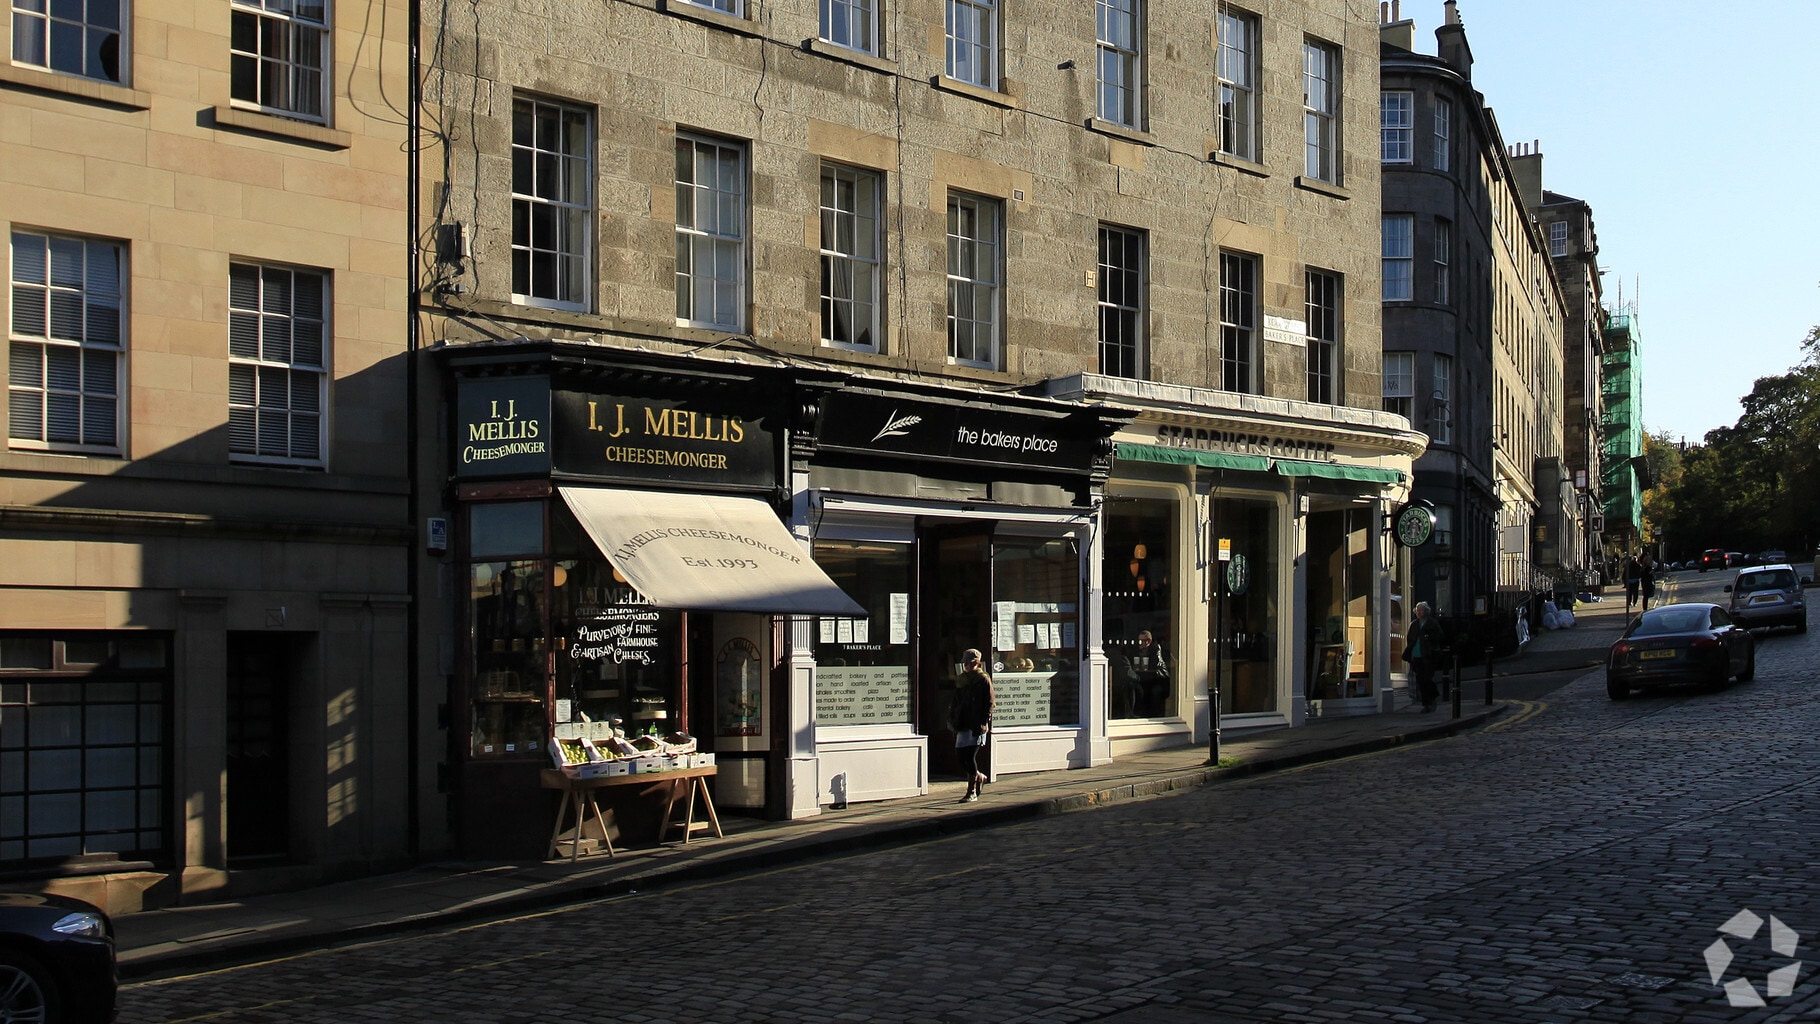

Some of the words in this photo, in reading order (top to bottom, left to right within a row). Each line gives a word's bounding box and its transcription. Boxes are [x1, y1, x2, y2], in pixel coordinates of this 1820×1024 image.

[491, 400, 501, 418] I.
[503, 399, 518, 421] J.
[587, 401, 603, 432] I.
[609, 404, 630, 438] J.
[644, 406, 744, 443] MELLIS
[468, 419, 539, 442] MELLIS
[957, 426, 979, 445] the
[981, 429, 1021, 449] bakers
[1021, 434, 1058, 453] place
[463, 441, 546, 463] CHEESEMONGER
[1157, 425, 1270, 456] STARBUCKS
[1271, 437, 1336, 462] COFFEE
[605, 445, 728, 470] CHEESEMONGER
[667, 527, 801, 565] CHEESEMONGER
[581, 643, 615, 660] ARTISAN
[617, 637, 659, 647] FARMHOUSE
